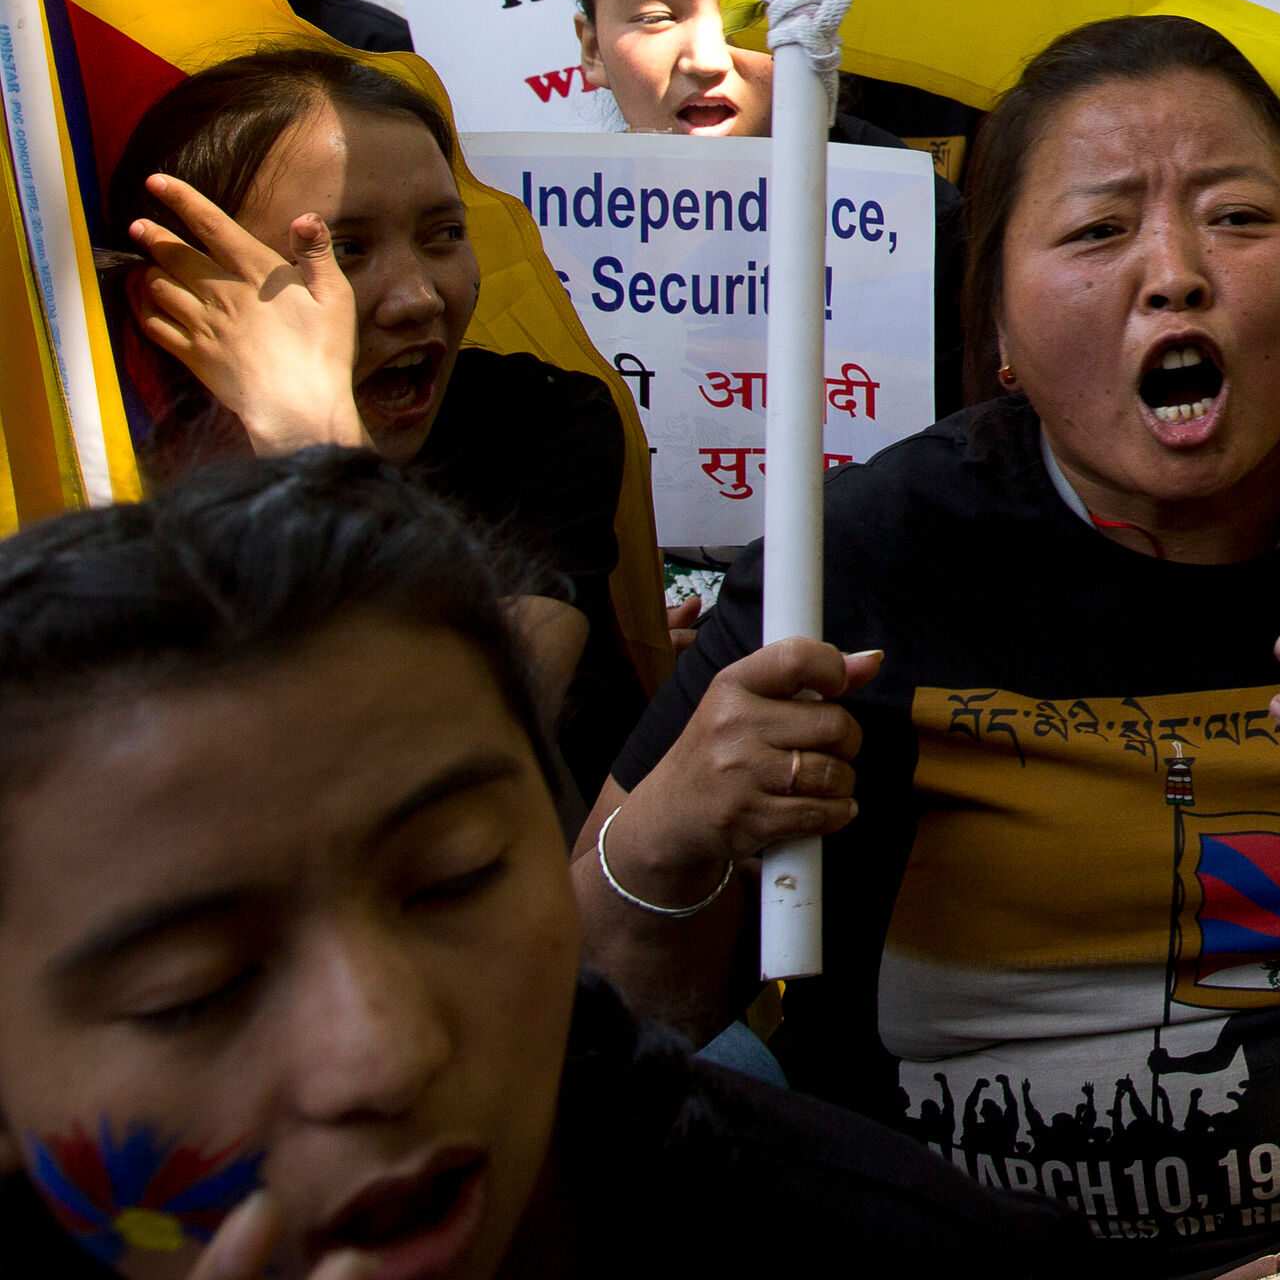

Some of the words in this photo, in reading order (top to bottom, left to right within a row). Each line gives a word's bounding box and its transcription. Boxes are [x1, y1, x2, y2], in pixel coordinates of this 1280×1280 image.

[0, 24, 20, 94] UNISTAR
[11, 101, 24, 125] PVC
[15, 129, 33, 182] CONDUIT
[25, 183, 40, 212] PIPE
[521, 171, 898, 254] Independce,
[40, 264, 57, 320] MEDIUM
[591, 256, 833, 320] Securit!
[1124, 1156, 1208, 1214] 10,
[1175, 1212, 1225, 1236] OF
